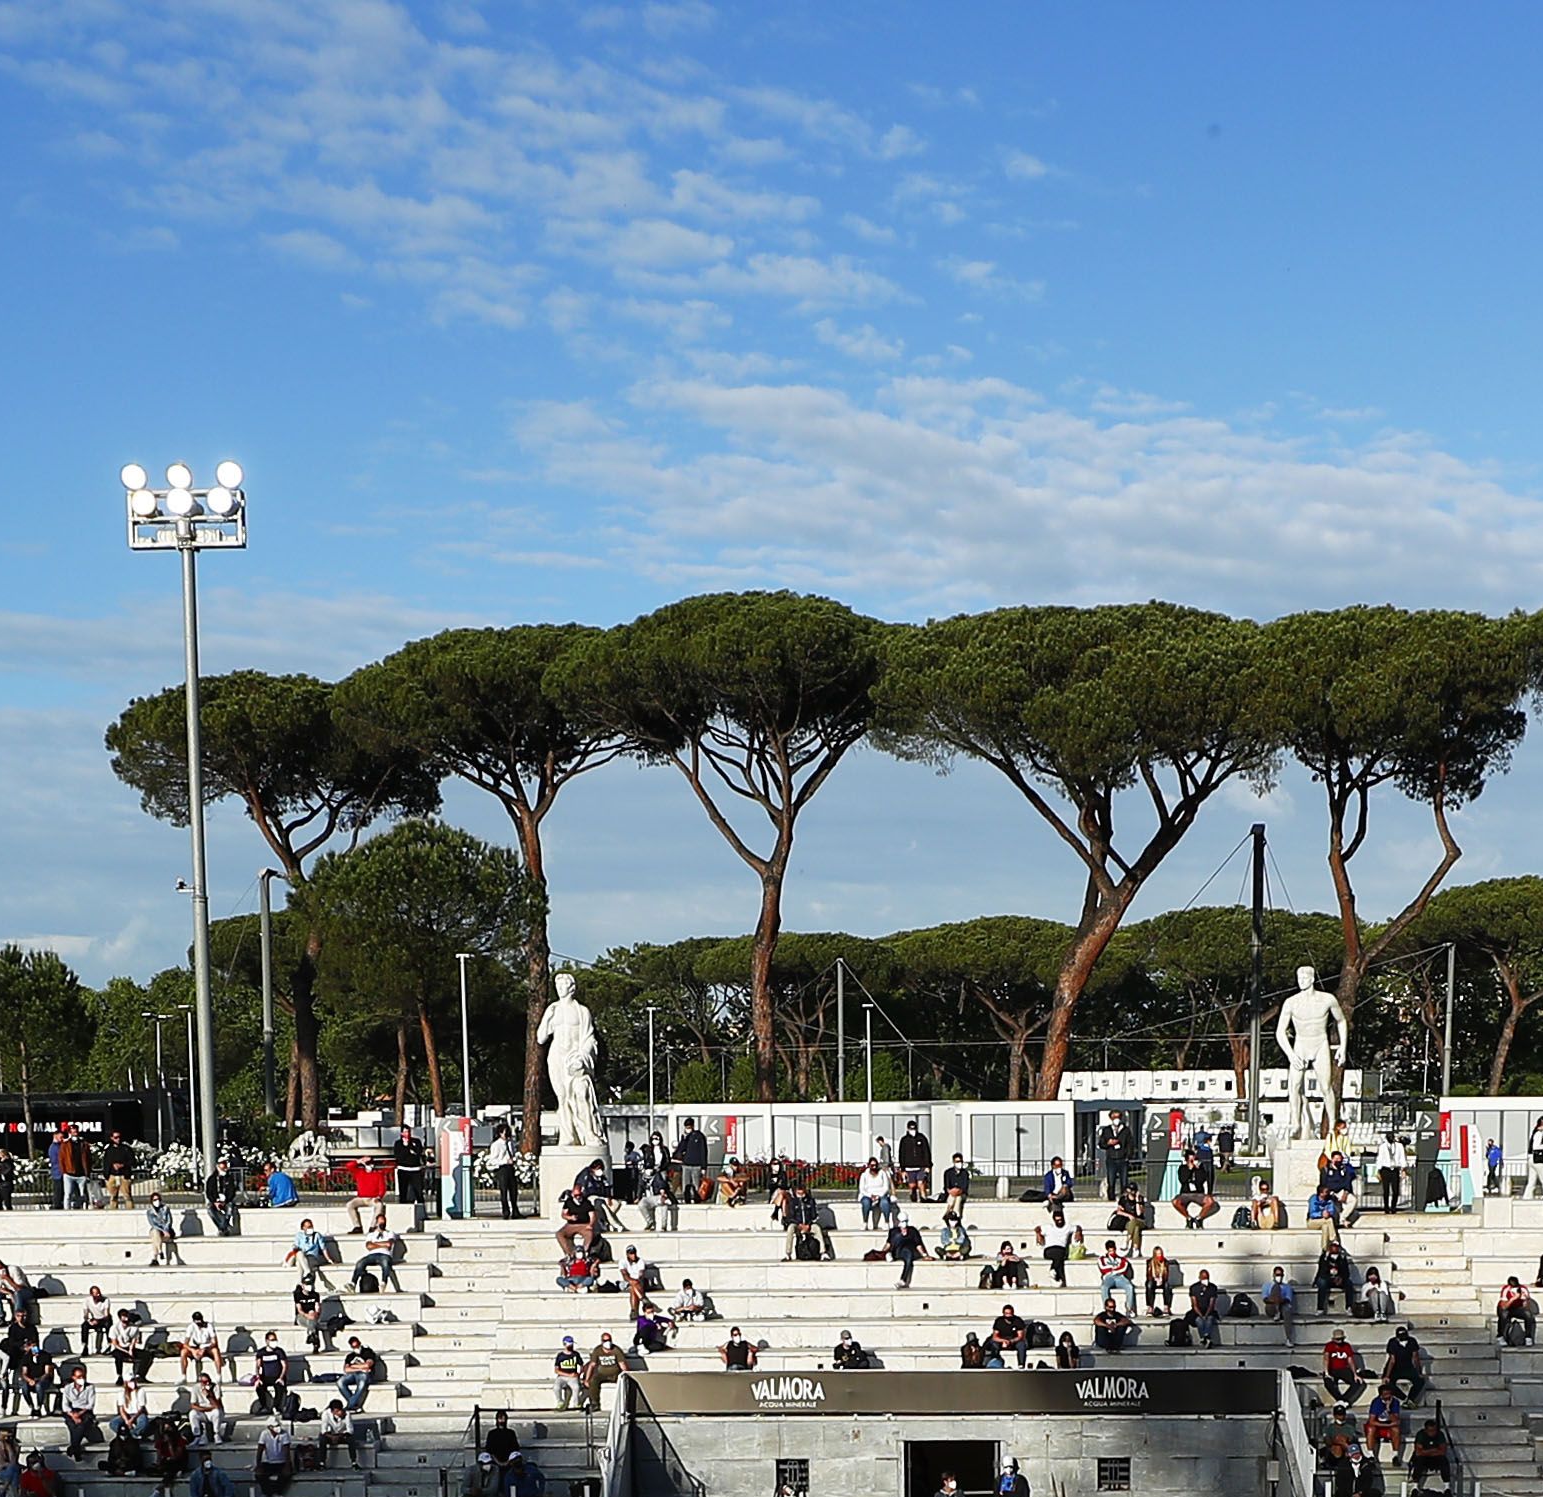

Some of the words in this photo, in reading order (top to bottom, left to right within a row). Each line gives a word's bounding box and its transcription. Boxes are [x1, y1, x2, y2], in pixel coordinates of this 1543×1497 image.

[9, 1122, 58, 1133] NOMAL
[751, 1376, 826, 1400] VALMORA
[1075, 1376, 1150, 1399] VALMORA
